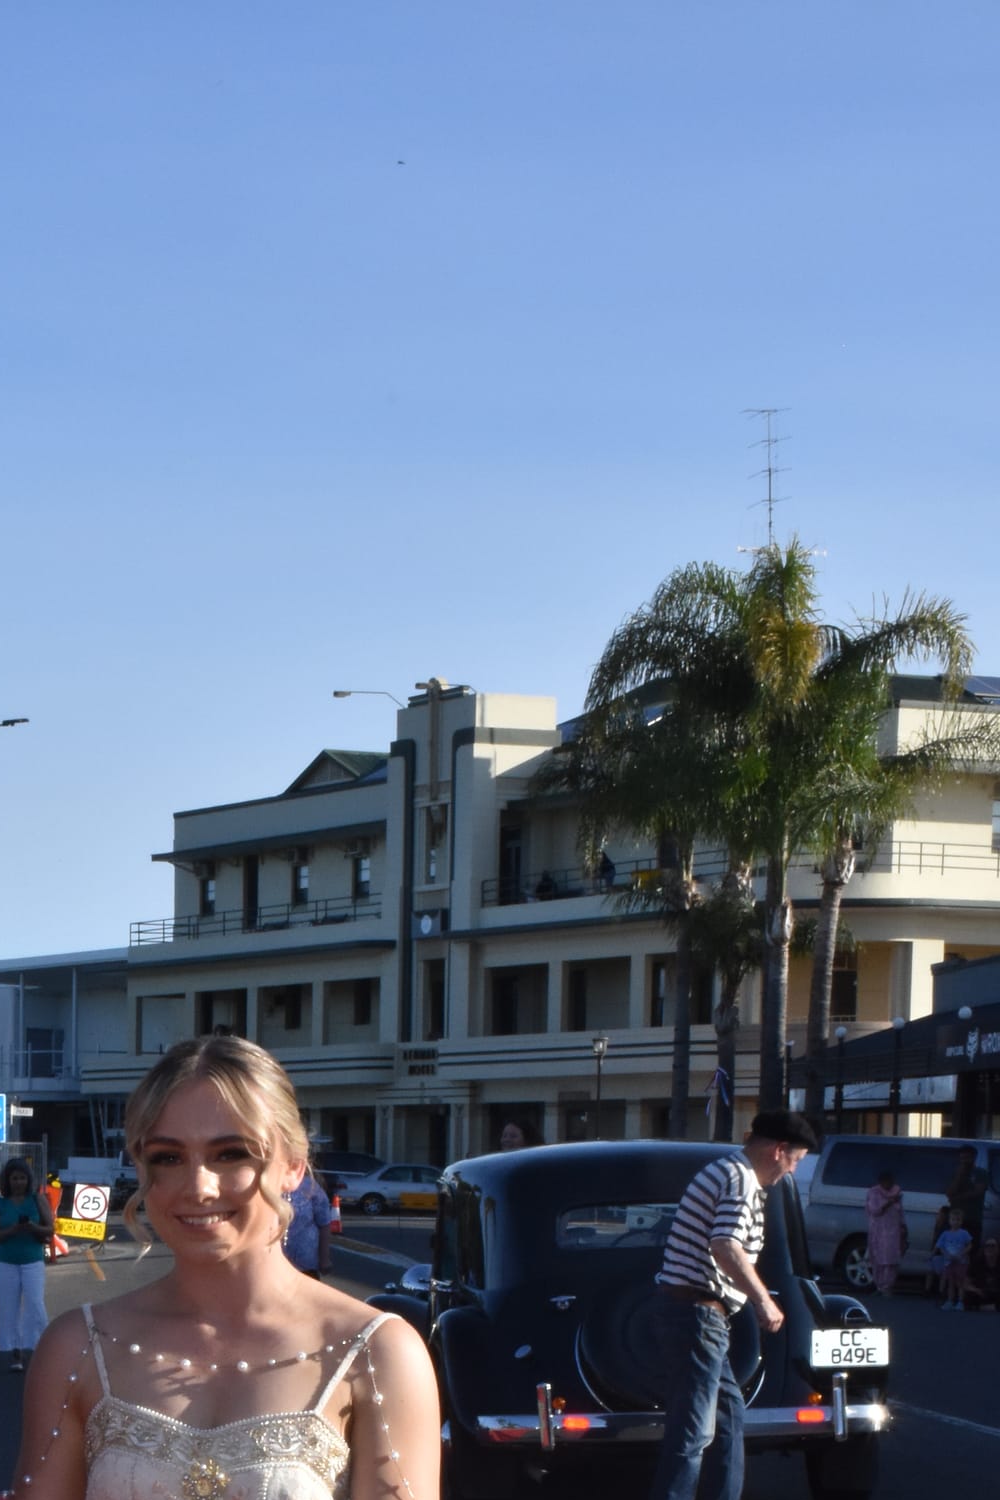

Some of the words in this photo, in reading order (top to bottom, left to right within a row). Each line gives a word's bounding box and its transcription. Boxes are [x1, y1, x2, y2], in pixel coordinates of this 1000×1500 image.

[81, 1195, 101, 1210] 25
[79, 1224, 103, 1236] AHEAD
[840, 1331, 861, 1346] CC
[831, 1348, 876, 1364] 849E
